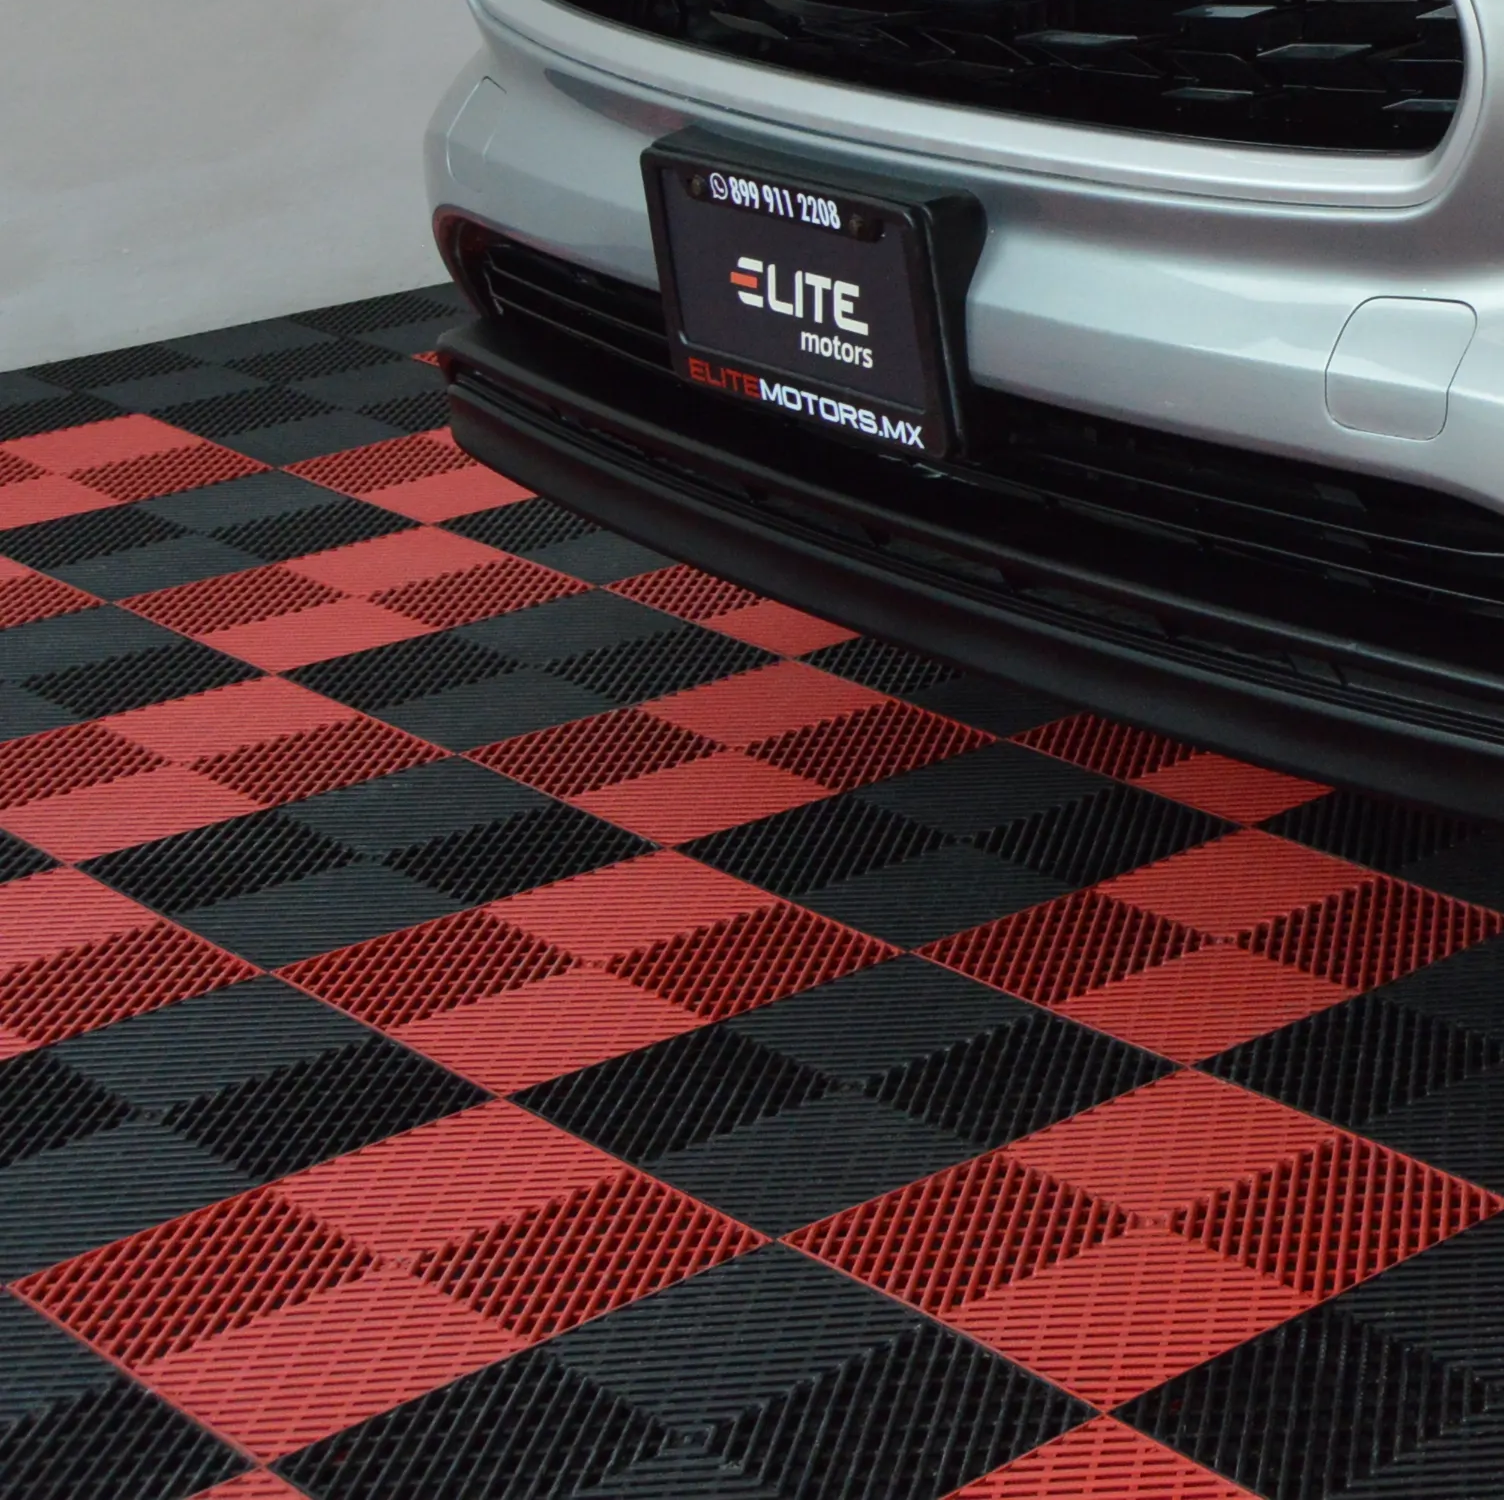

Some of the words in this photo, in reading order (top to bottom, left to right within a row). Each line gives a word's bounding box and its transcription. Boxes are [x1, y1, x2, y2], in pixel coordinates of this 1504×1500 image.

[728, 176, 760, 210] 899
[762, 184, 794, 218] 911
[796, 192, 841, 230] 2208
[730, 256, 869, 336] ELITE
[800, 330, 874, 369] motors
[688, 356, 926, 450] ELITEMOTORS.MX
